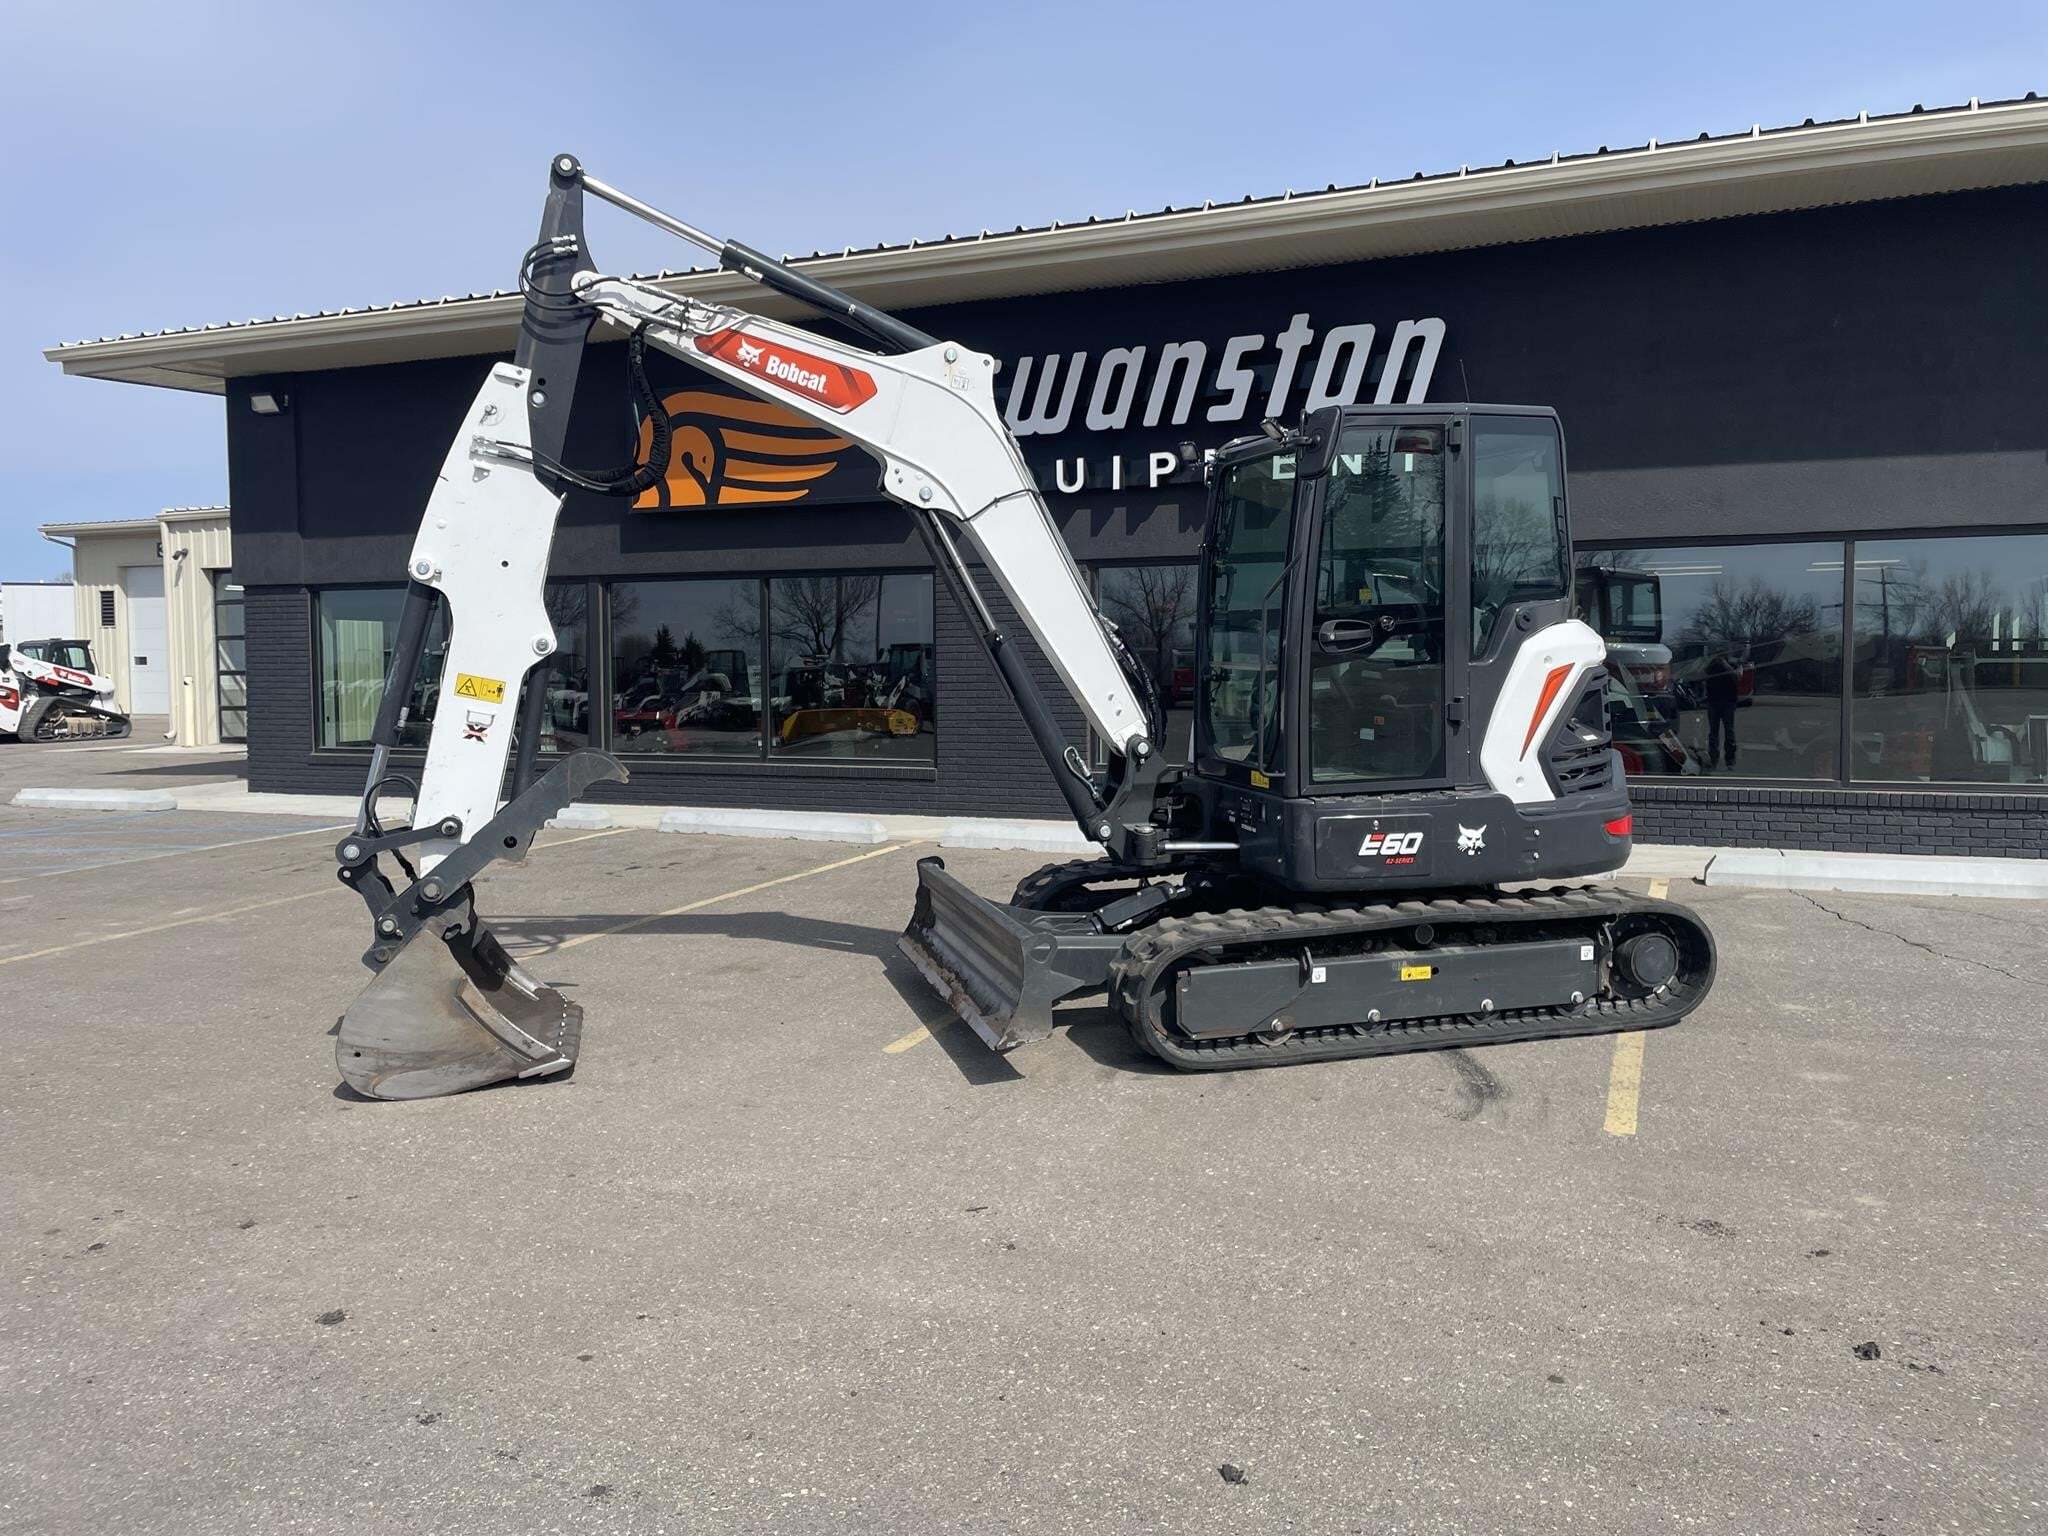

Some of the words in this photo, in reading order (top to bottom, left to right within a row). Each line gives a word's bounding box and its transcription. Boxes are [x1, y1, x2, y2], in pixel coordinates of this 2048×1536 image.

[765, 354, 827, 393] Bobcat
[994, 313, 1447, 436] wanston
[1358, 832, 1424, 856] E60
